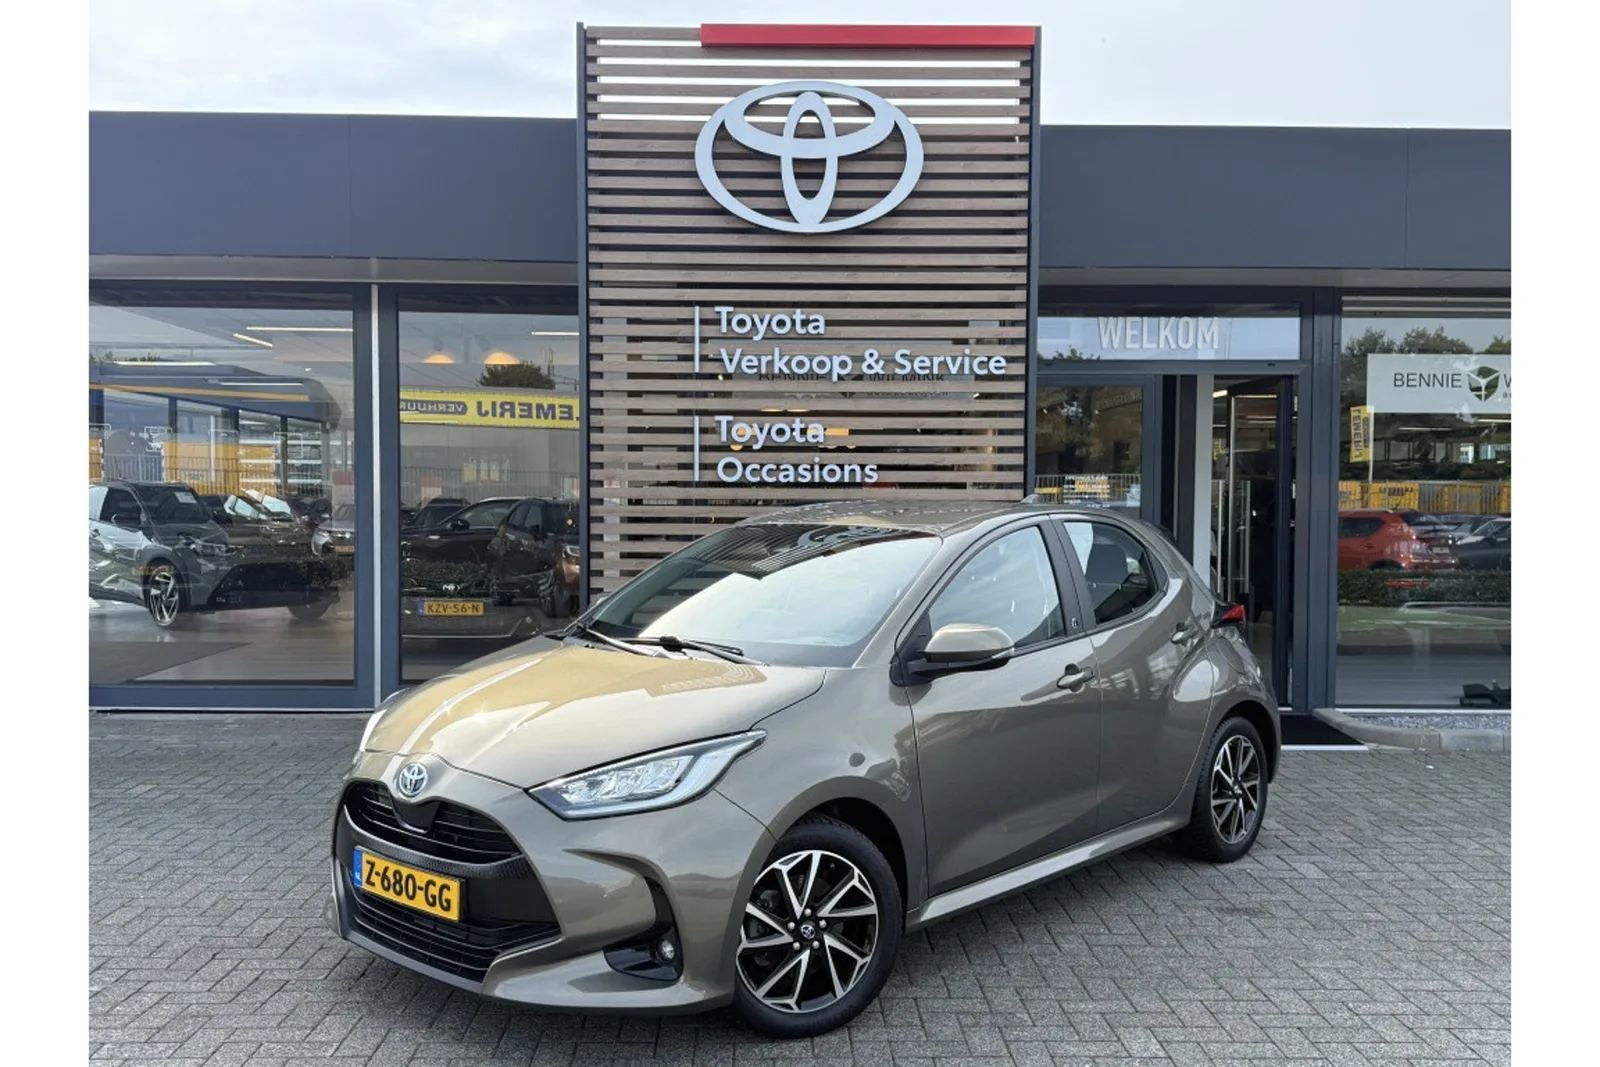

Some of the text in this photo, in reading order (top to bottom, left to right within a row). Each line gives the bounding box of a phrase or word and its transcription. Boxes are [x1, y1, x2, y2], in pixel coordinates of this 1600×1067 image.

[714, 306, 825, 341] Toyota
[1098, 317, 1219, 349] WELKOM
[720, 347, 1007, 382] Verkoop & Service
[1393, 372, 1462, 388] BENNIE
[714, 415, 825, 449] Toyota
[716, 457, 879, 483] Occasions
[427, 603, 480, 614] KZV-56-N
[365, 859, 452, 912] Z-680-GG
